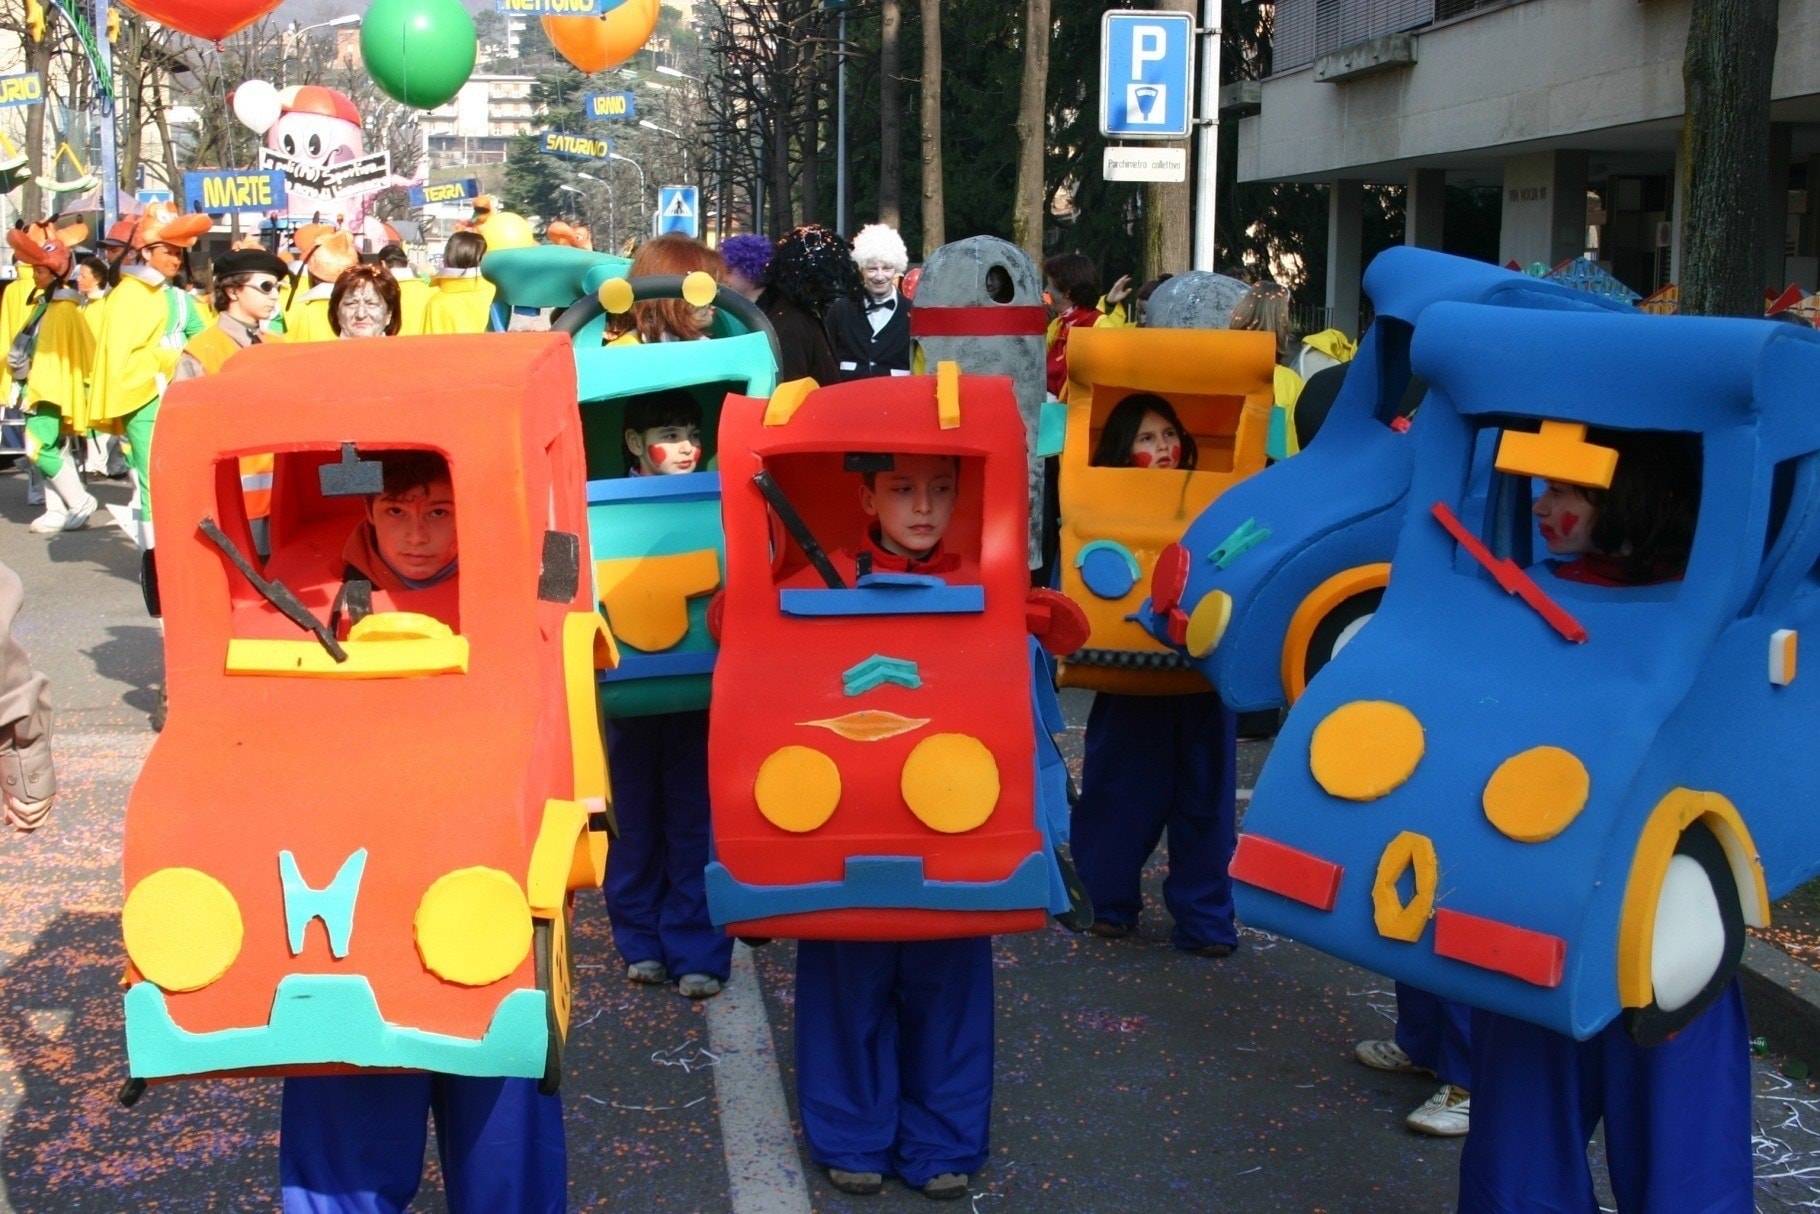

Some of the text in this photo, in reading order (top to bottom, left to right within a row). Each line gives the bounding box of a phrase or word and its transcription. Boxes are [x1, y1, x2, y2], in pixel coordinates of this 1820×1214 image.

[1131, 25, 1166, 80] P
[594, 96, 625, 115] URANO
[546, 133, 608, 158] SATURNO
[1107, 158, 1181, 169] Parchimetro collettivo
[203, 174, 272, 208] MARTE
[423, 182, 465, 202] TERRA
